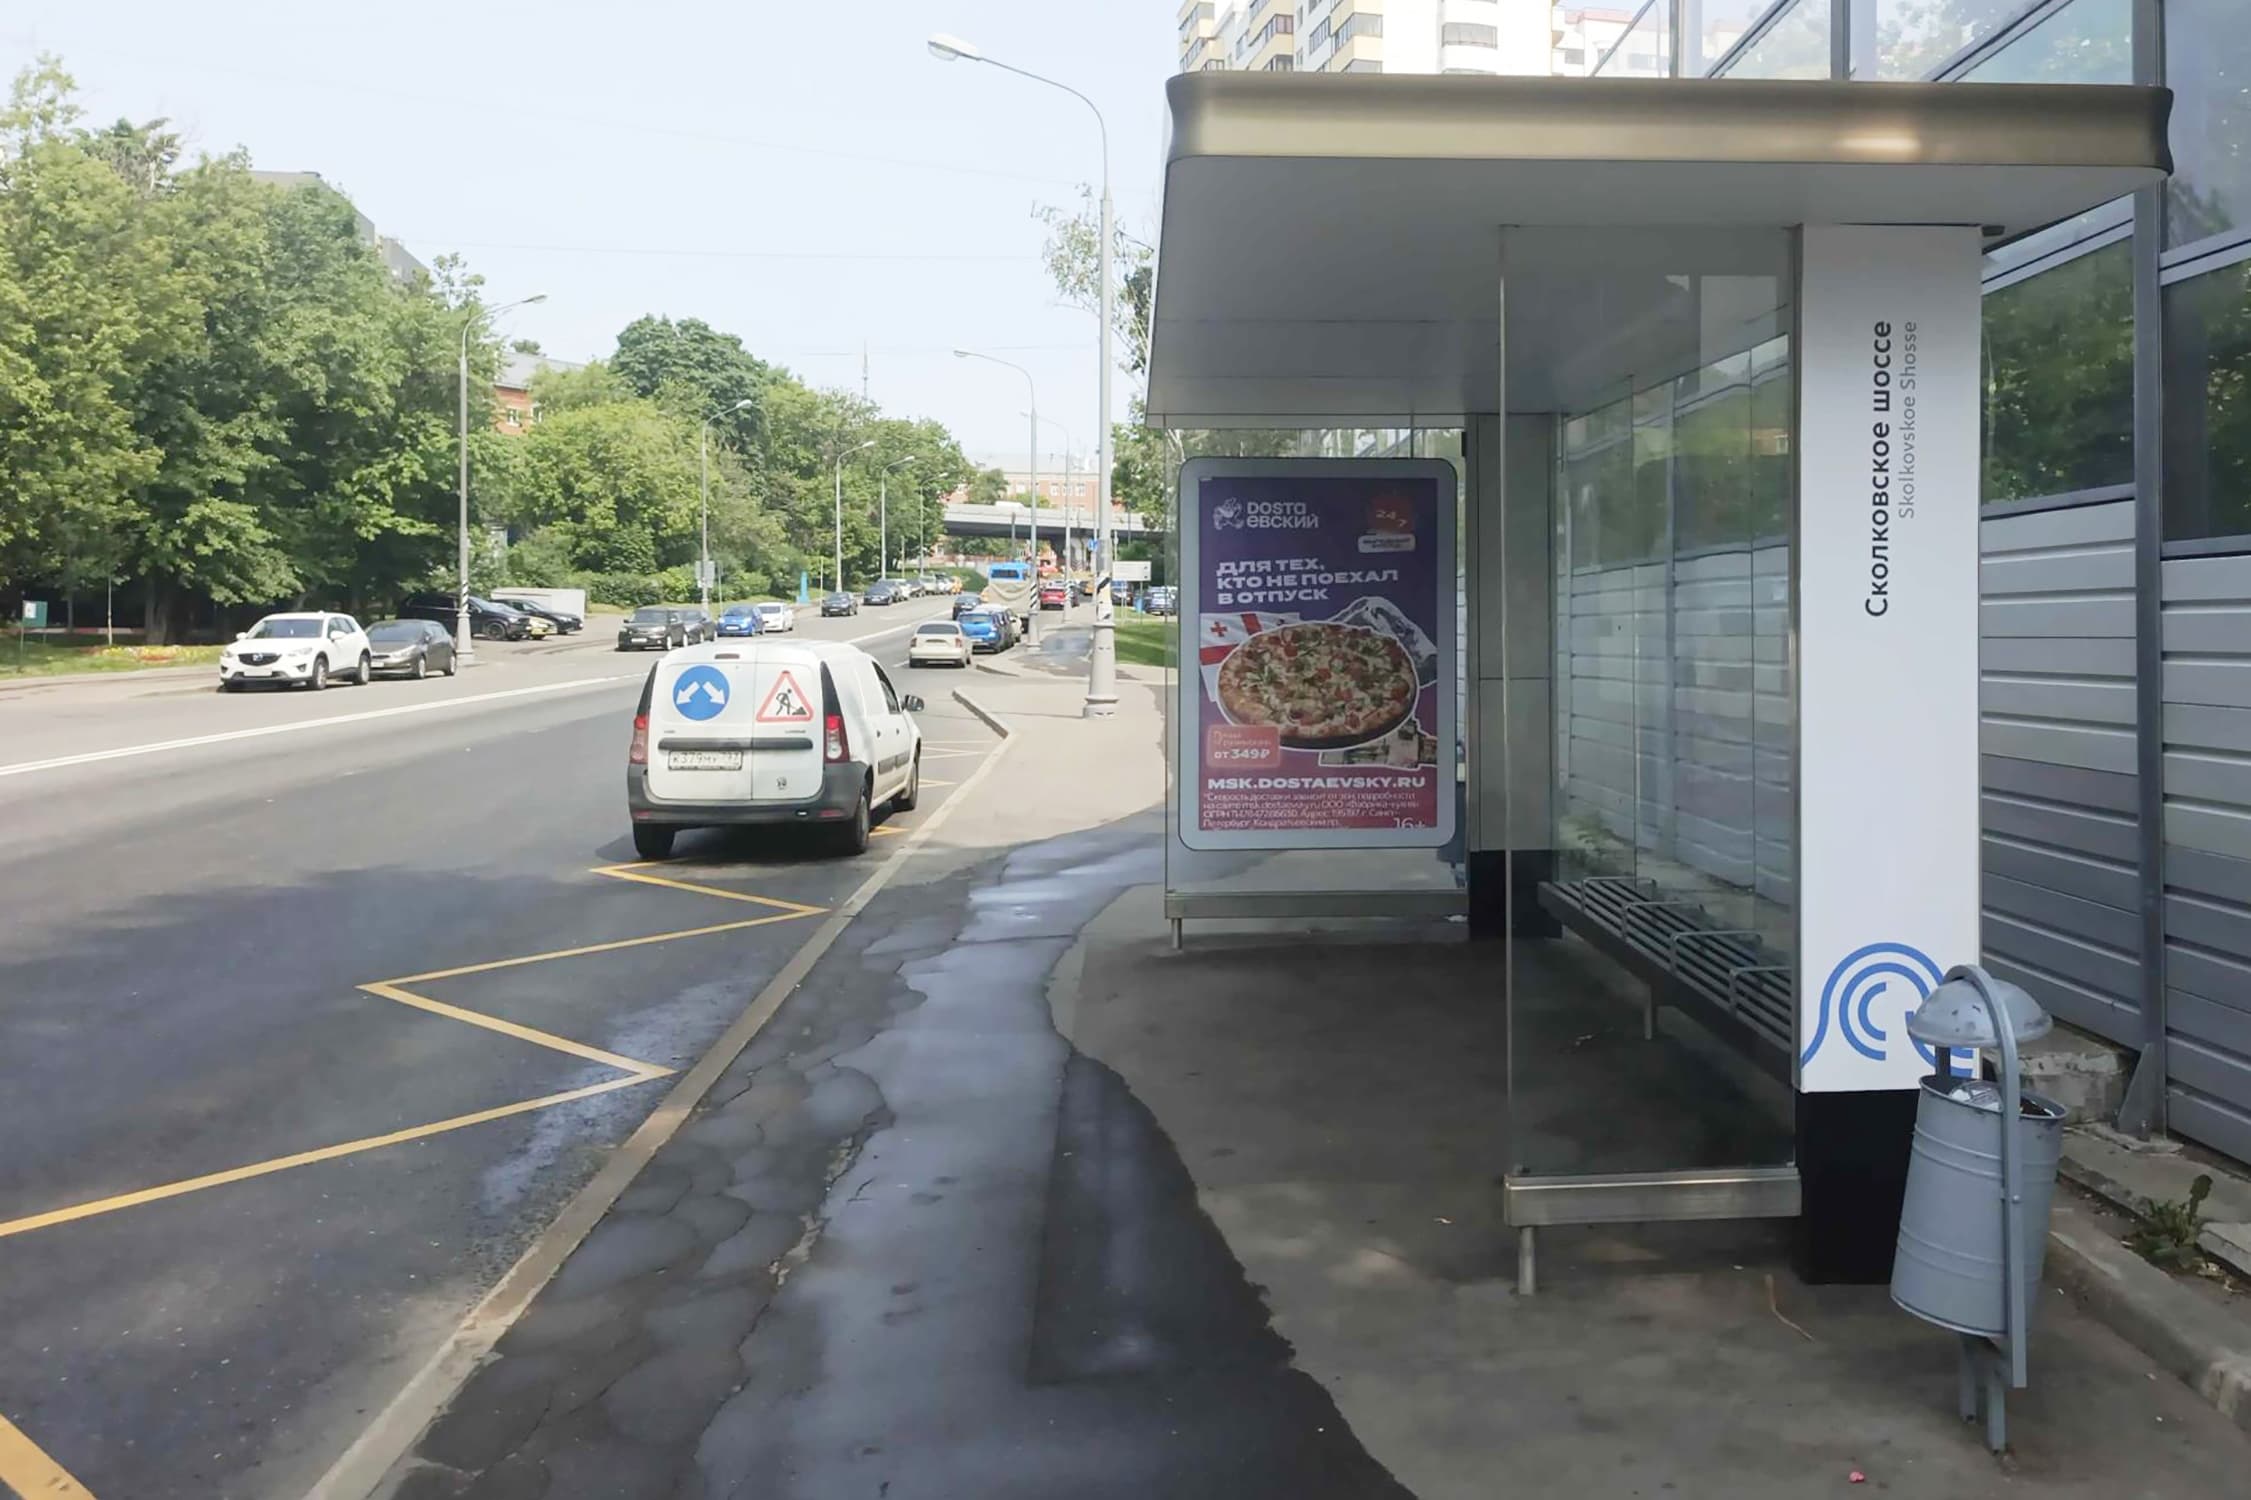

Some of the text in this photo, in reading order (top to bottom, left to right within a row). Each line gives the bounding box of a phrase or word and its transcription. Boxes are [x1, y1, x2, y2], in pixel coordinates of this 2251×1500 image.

[1898, 321, 1918, 519] Skolkovskoe Shosse
[1865, 321, 1892, 617] Сколковское шоссе
[1216, 558, 1325, 577] ДЛЯ ТЕХ,
[1217, 569, 1399, 590] КТО НЕ ПОЕХАЛ
[1217, 588, 1329, 605] В ОТПУСК
[1214, 751, 1230, 759] от
[1207, 776, 1426, 790] MSK.DOSTAEVSKY.RU
